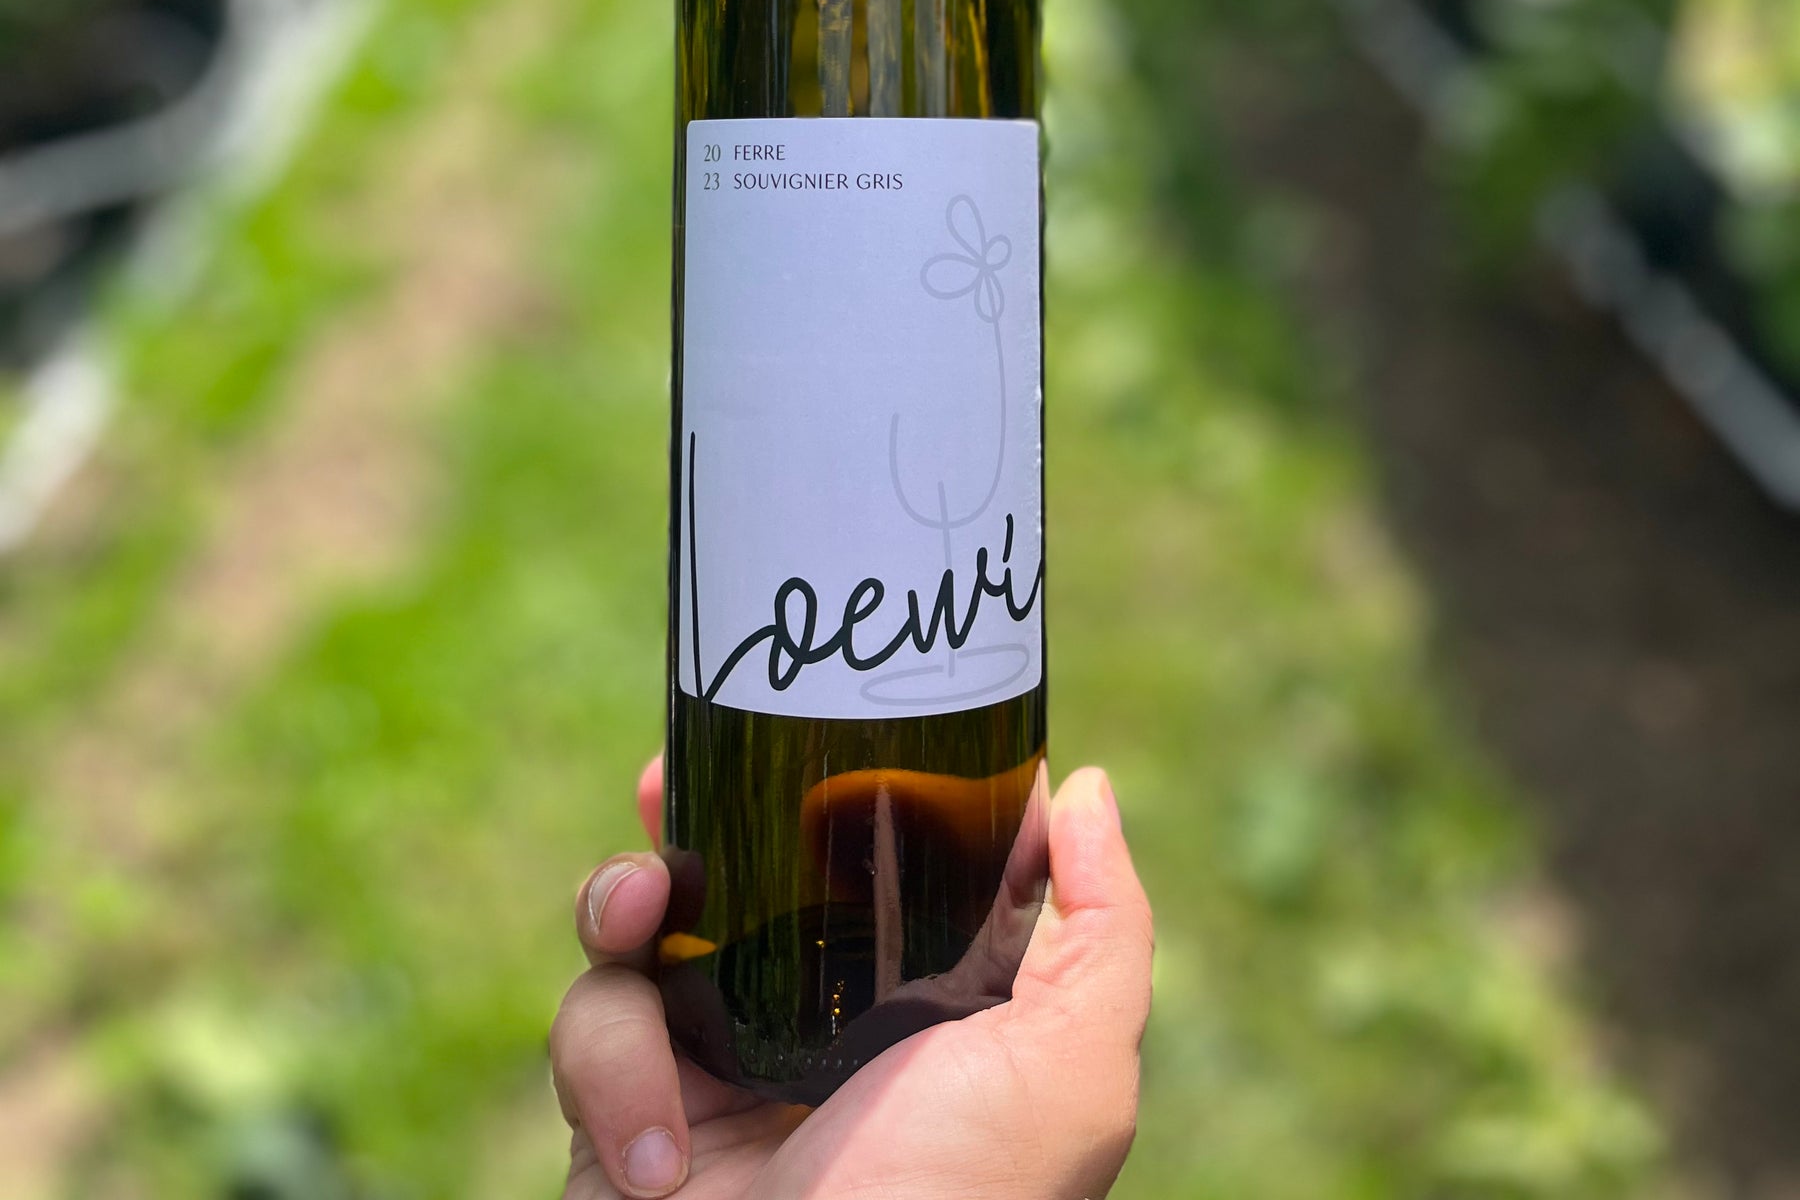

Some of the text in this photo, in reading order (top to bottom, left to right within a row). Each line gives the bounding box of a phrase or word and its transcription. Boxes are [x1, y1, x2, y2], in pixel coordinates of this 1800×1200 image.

[703, 144, 786, 162] 20 FERRE
[703, 172, 903, 191] 23 SOUVIGNIER GRIS
